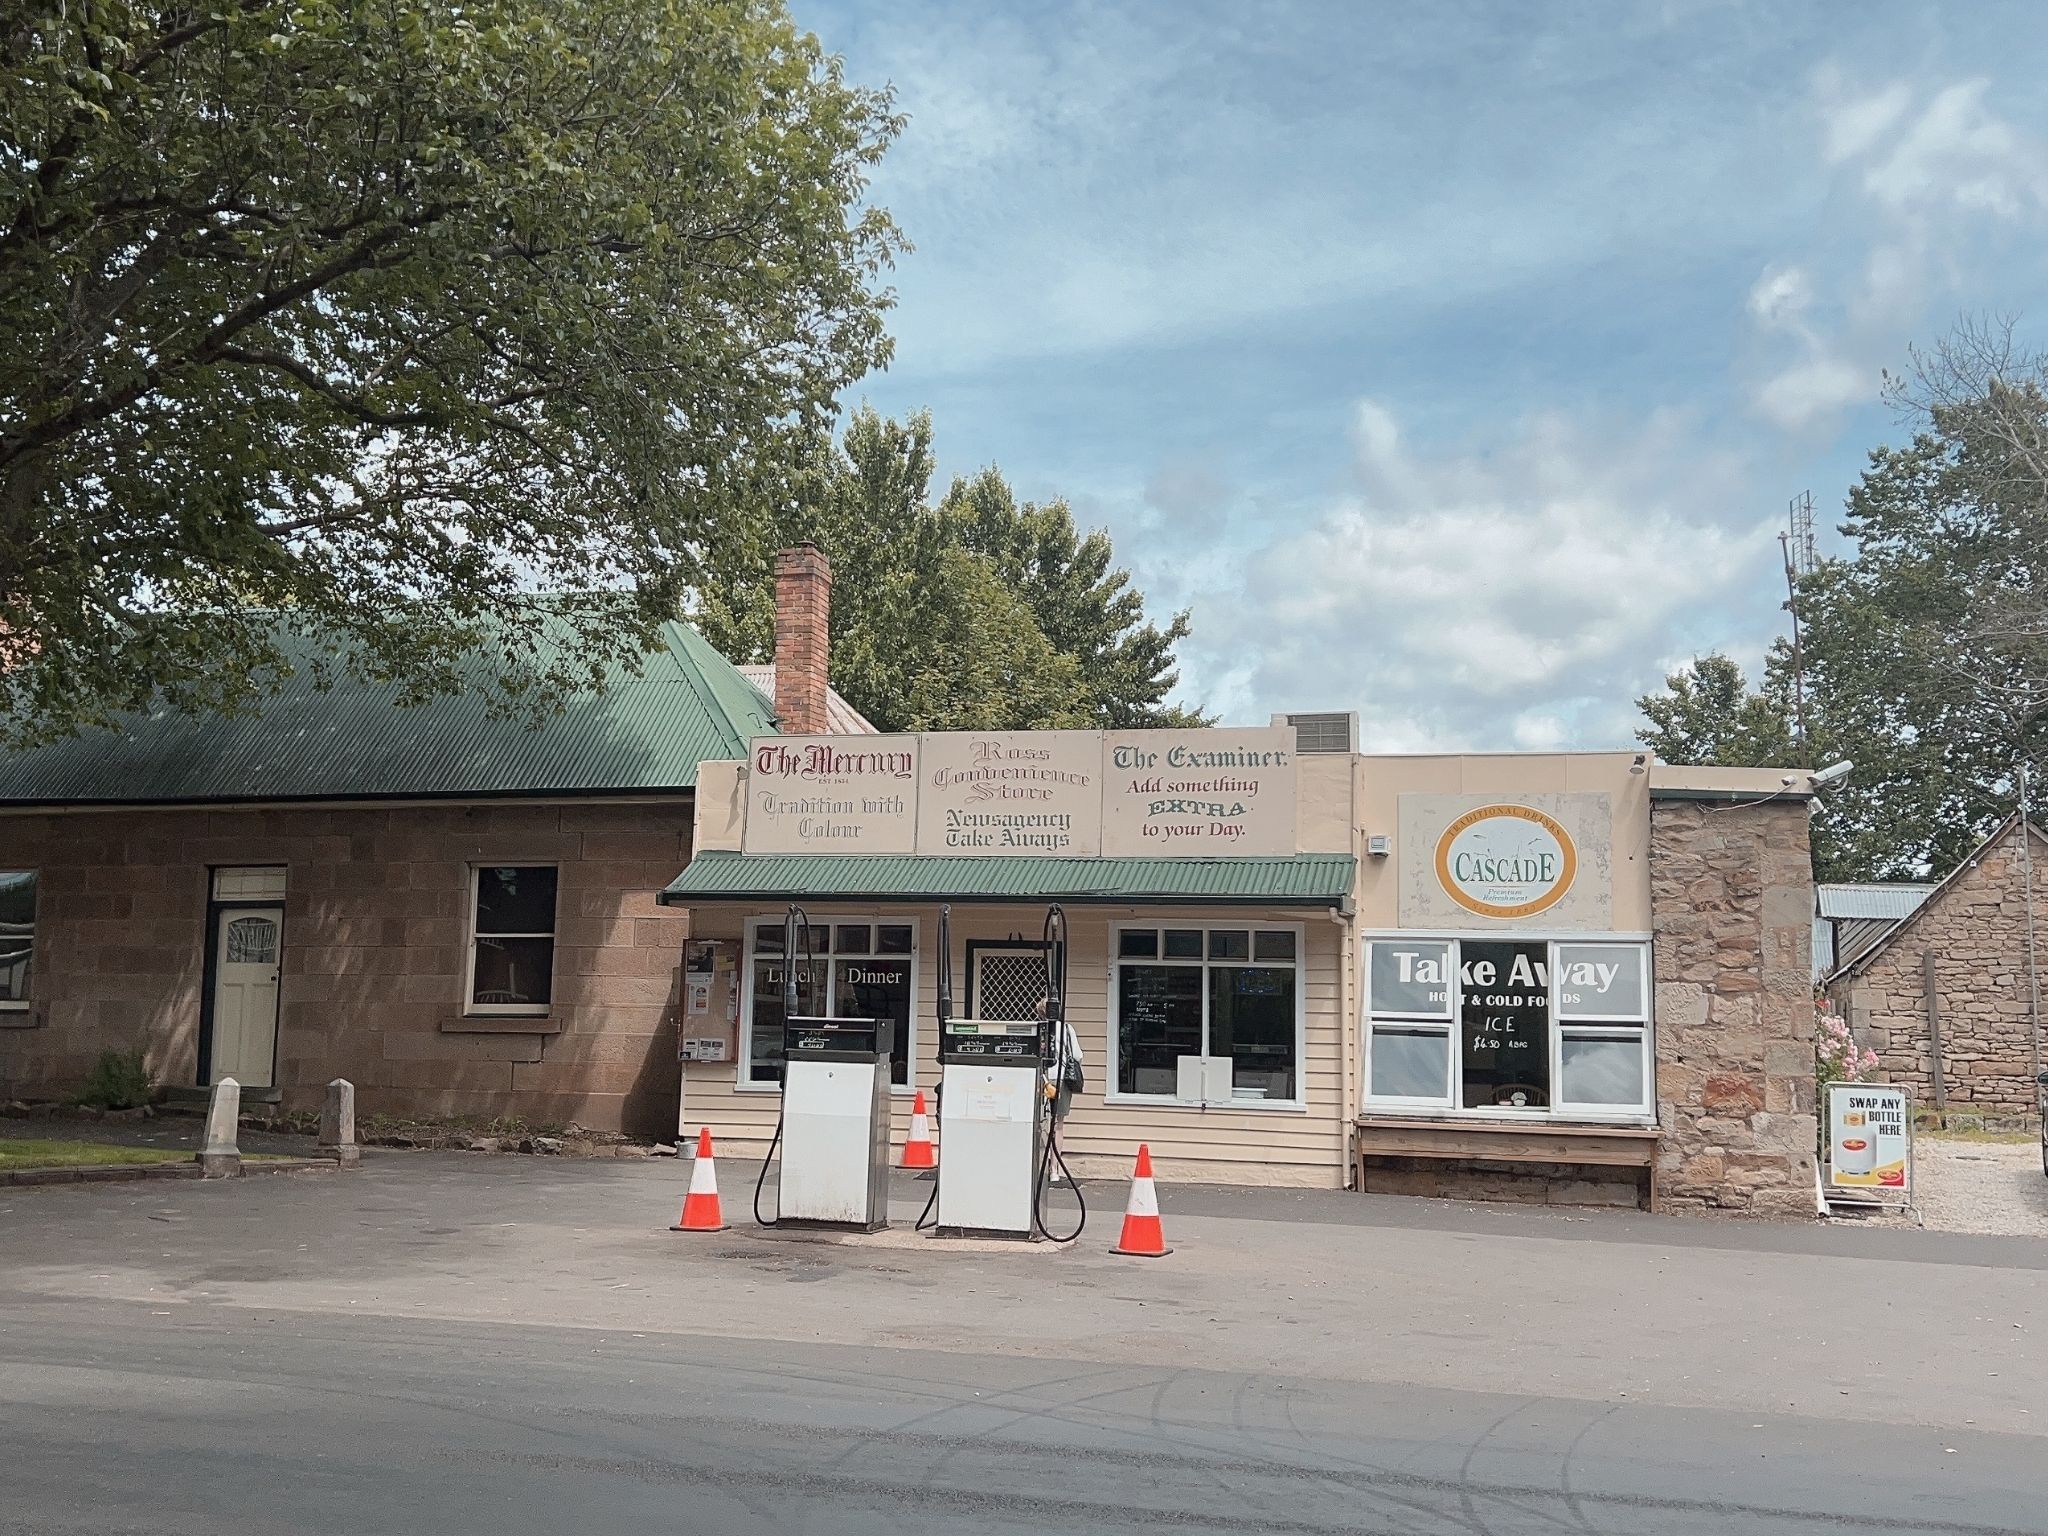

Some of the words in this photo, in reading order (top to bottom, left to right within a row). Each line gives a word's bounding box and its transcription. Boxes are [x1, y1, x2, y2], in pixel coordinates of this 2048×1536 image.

[756, 745, 801, 779] The
[800, 744, 913, 780] Mercury
[970, 741, 1051, 768] Ross
[1113, 745, 1158, 770] The
[932, 765, 1091, 791] Convenience
[1125, 777, 1164, 794] Add
[1166, 775, 1259, 797] something
[964, 781, 1053, 804] Store
[758, 791, 853, 826] Tradition
[862, 795, 905, 818] with
[946, 809, 1071, 831] Newsagency
[1148, 799, 1247, 818] EXTRA
[799, 817, 863, 844] Colour
[1142, 824, 1159, 836] to
[1161, 824, 1204, 842] your
[1209, 822, 1246, 842] Day.
[1447, 807, 1519, 837] TRADITIONAL
[946, 828, 993, 847] Take
[999, 828, 1070, 851] Aways
[848, 967, 902, 984] Dinner
[1393, 952, 1496, 987] Take
[1507, 953, 1619, 993] Away
[1471, 995, 1481, 1006] &
[1485, 994, 1523, 1007] COLD
[1528, 993, 1581, 1007] FODS
[1485, 1016, 1516, 1032] ICE
[1849, 1097, 1878, 1109] SWAP
[1880, 1098, 1901, 1109] ANY
[1868, 1111, 1902, 1122] BOTTLE
[1879, 1124, 1902, 1136] HERE
